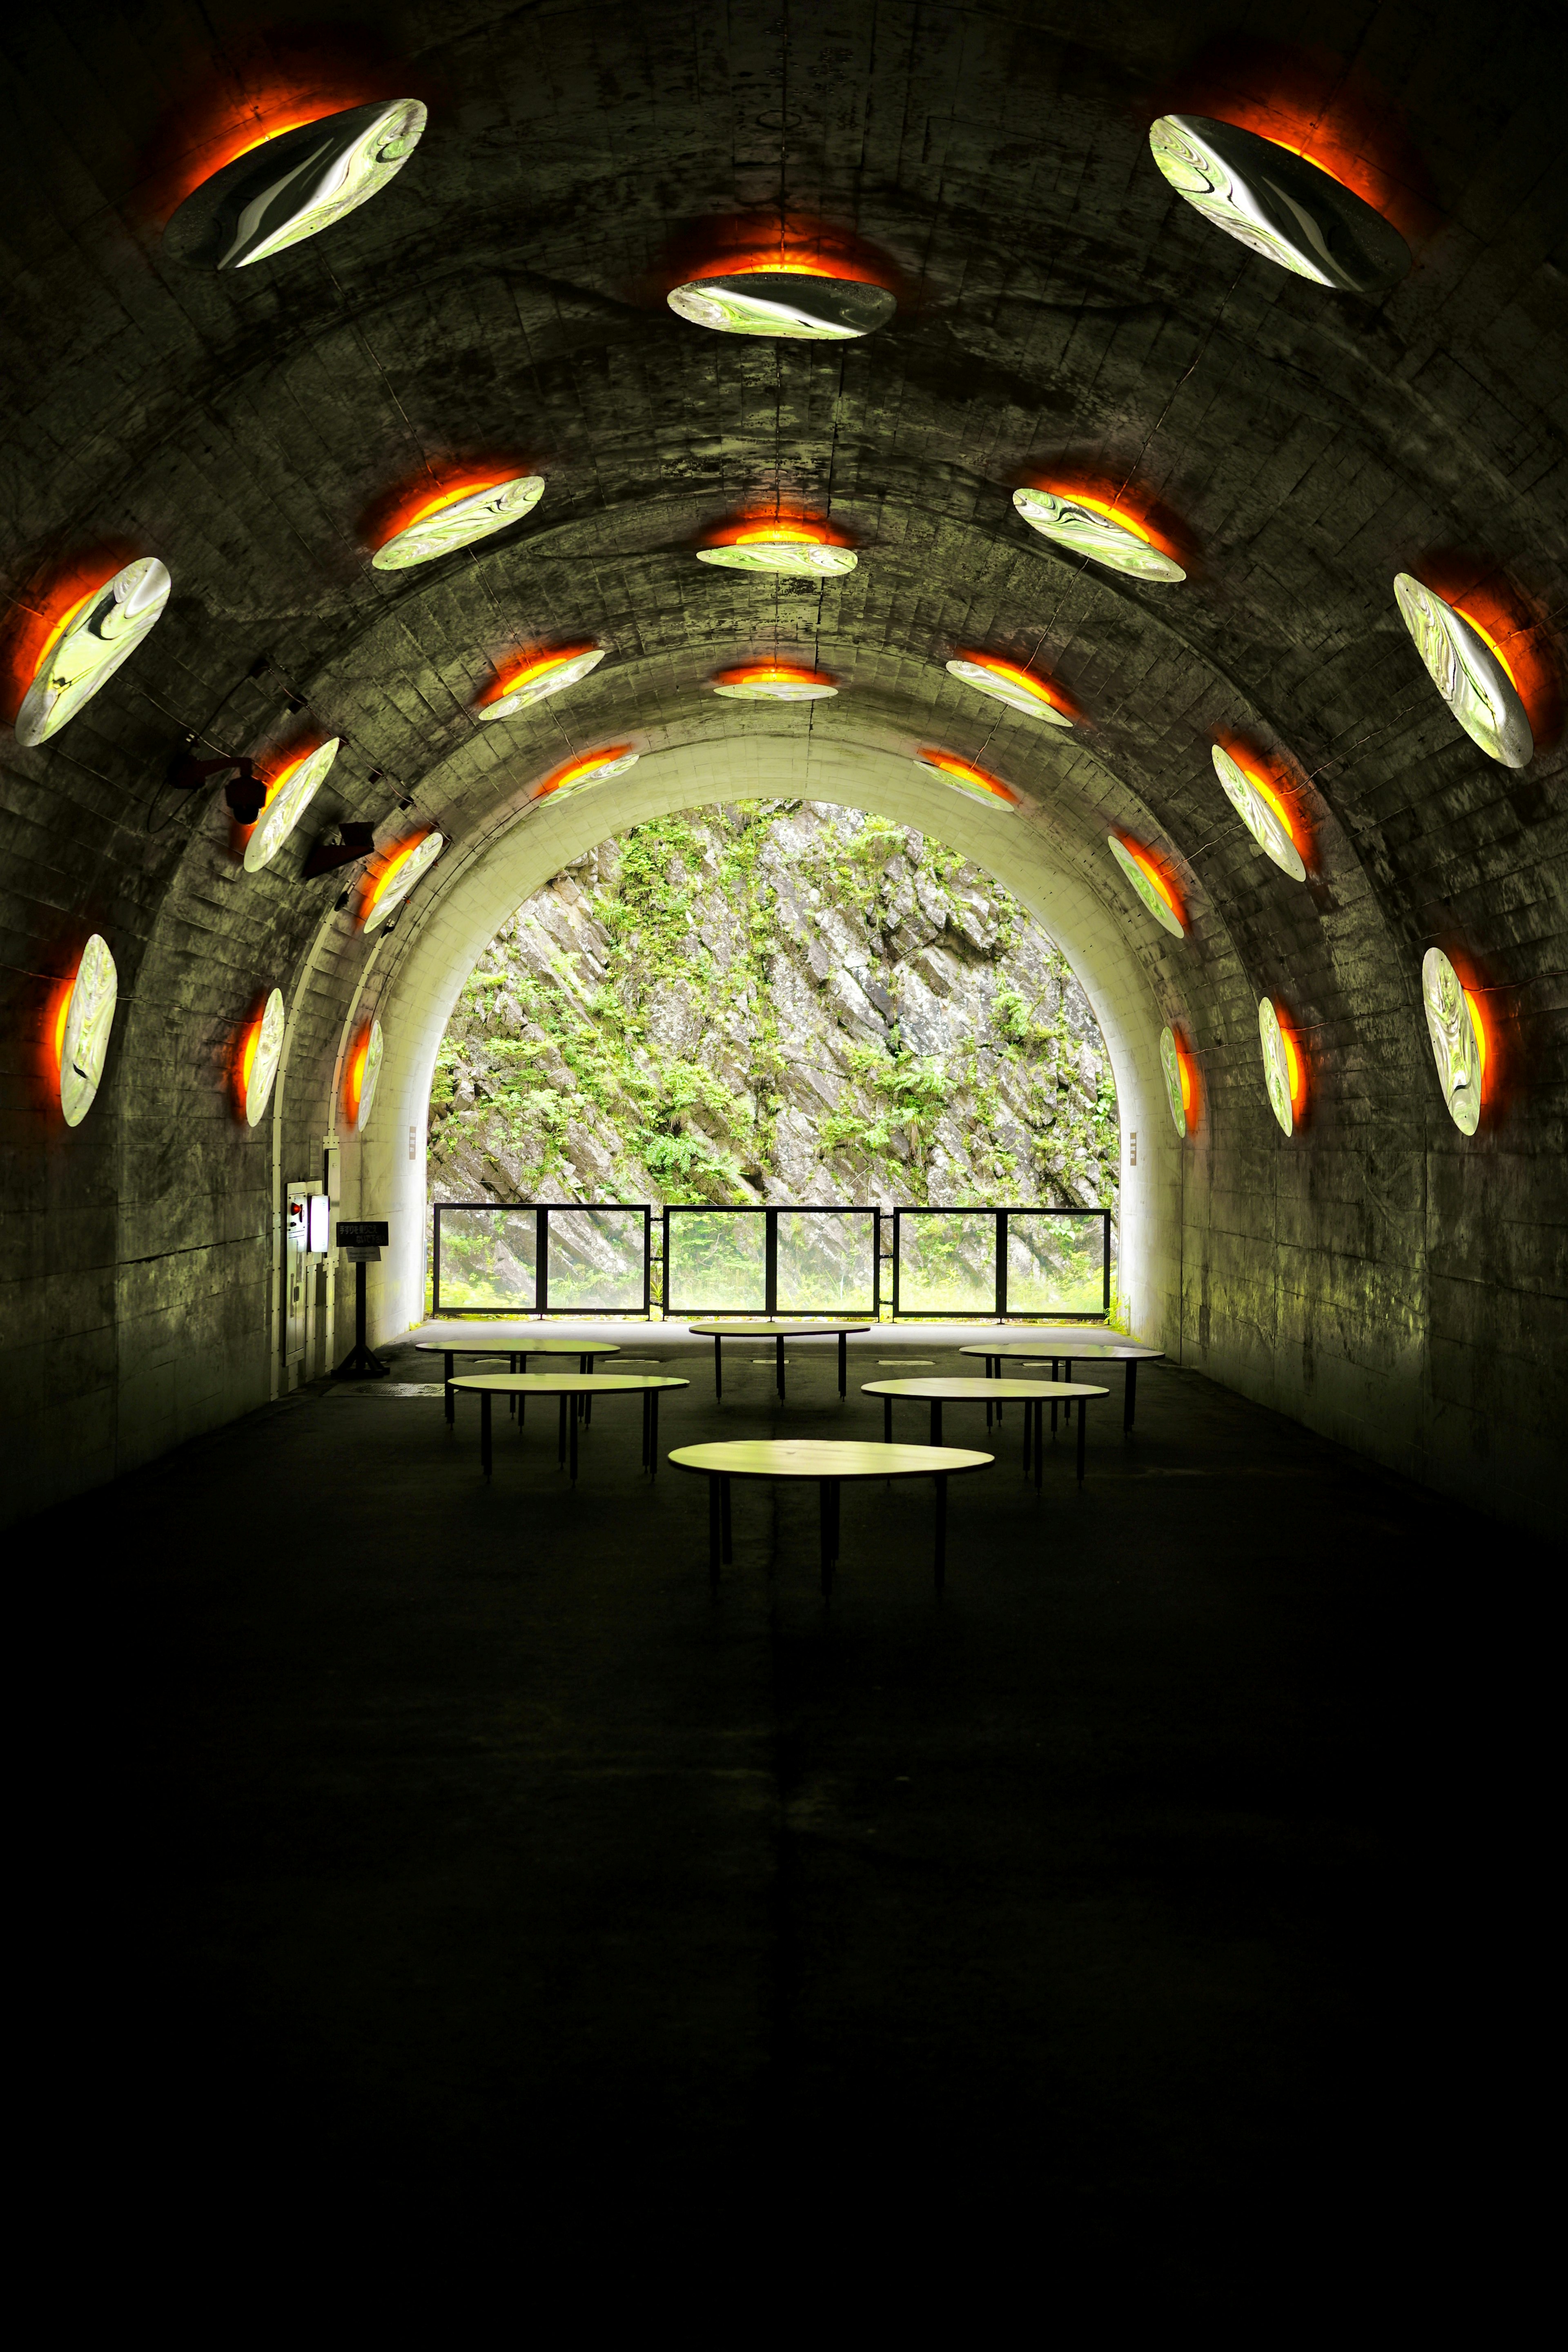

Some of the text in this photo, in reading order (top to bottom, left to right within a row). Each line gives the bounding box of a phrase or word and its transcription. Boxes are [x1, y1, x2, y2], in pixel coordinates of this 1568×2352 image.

[339, 1225, 378, 1234] 手すりを乗りこえ
